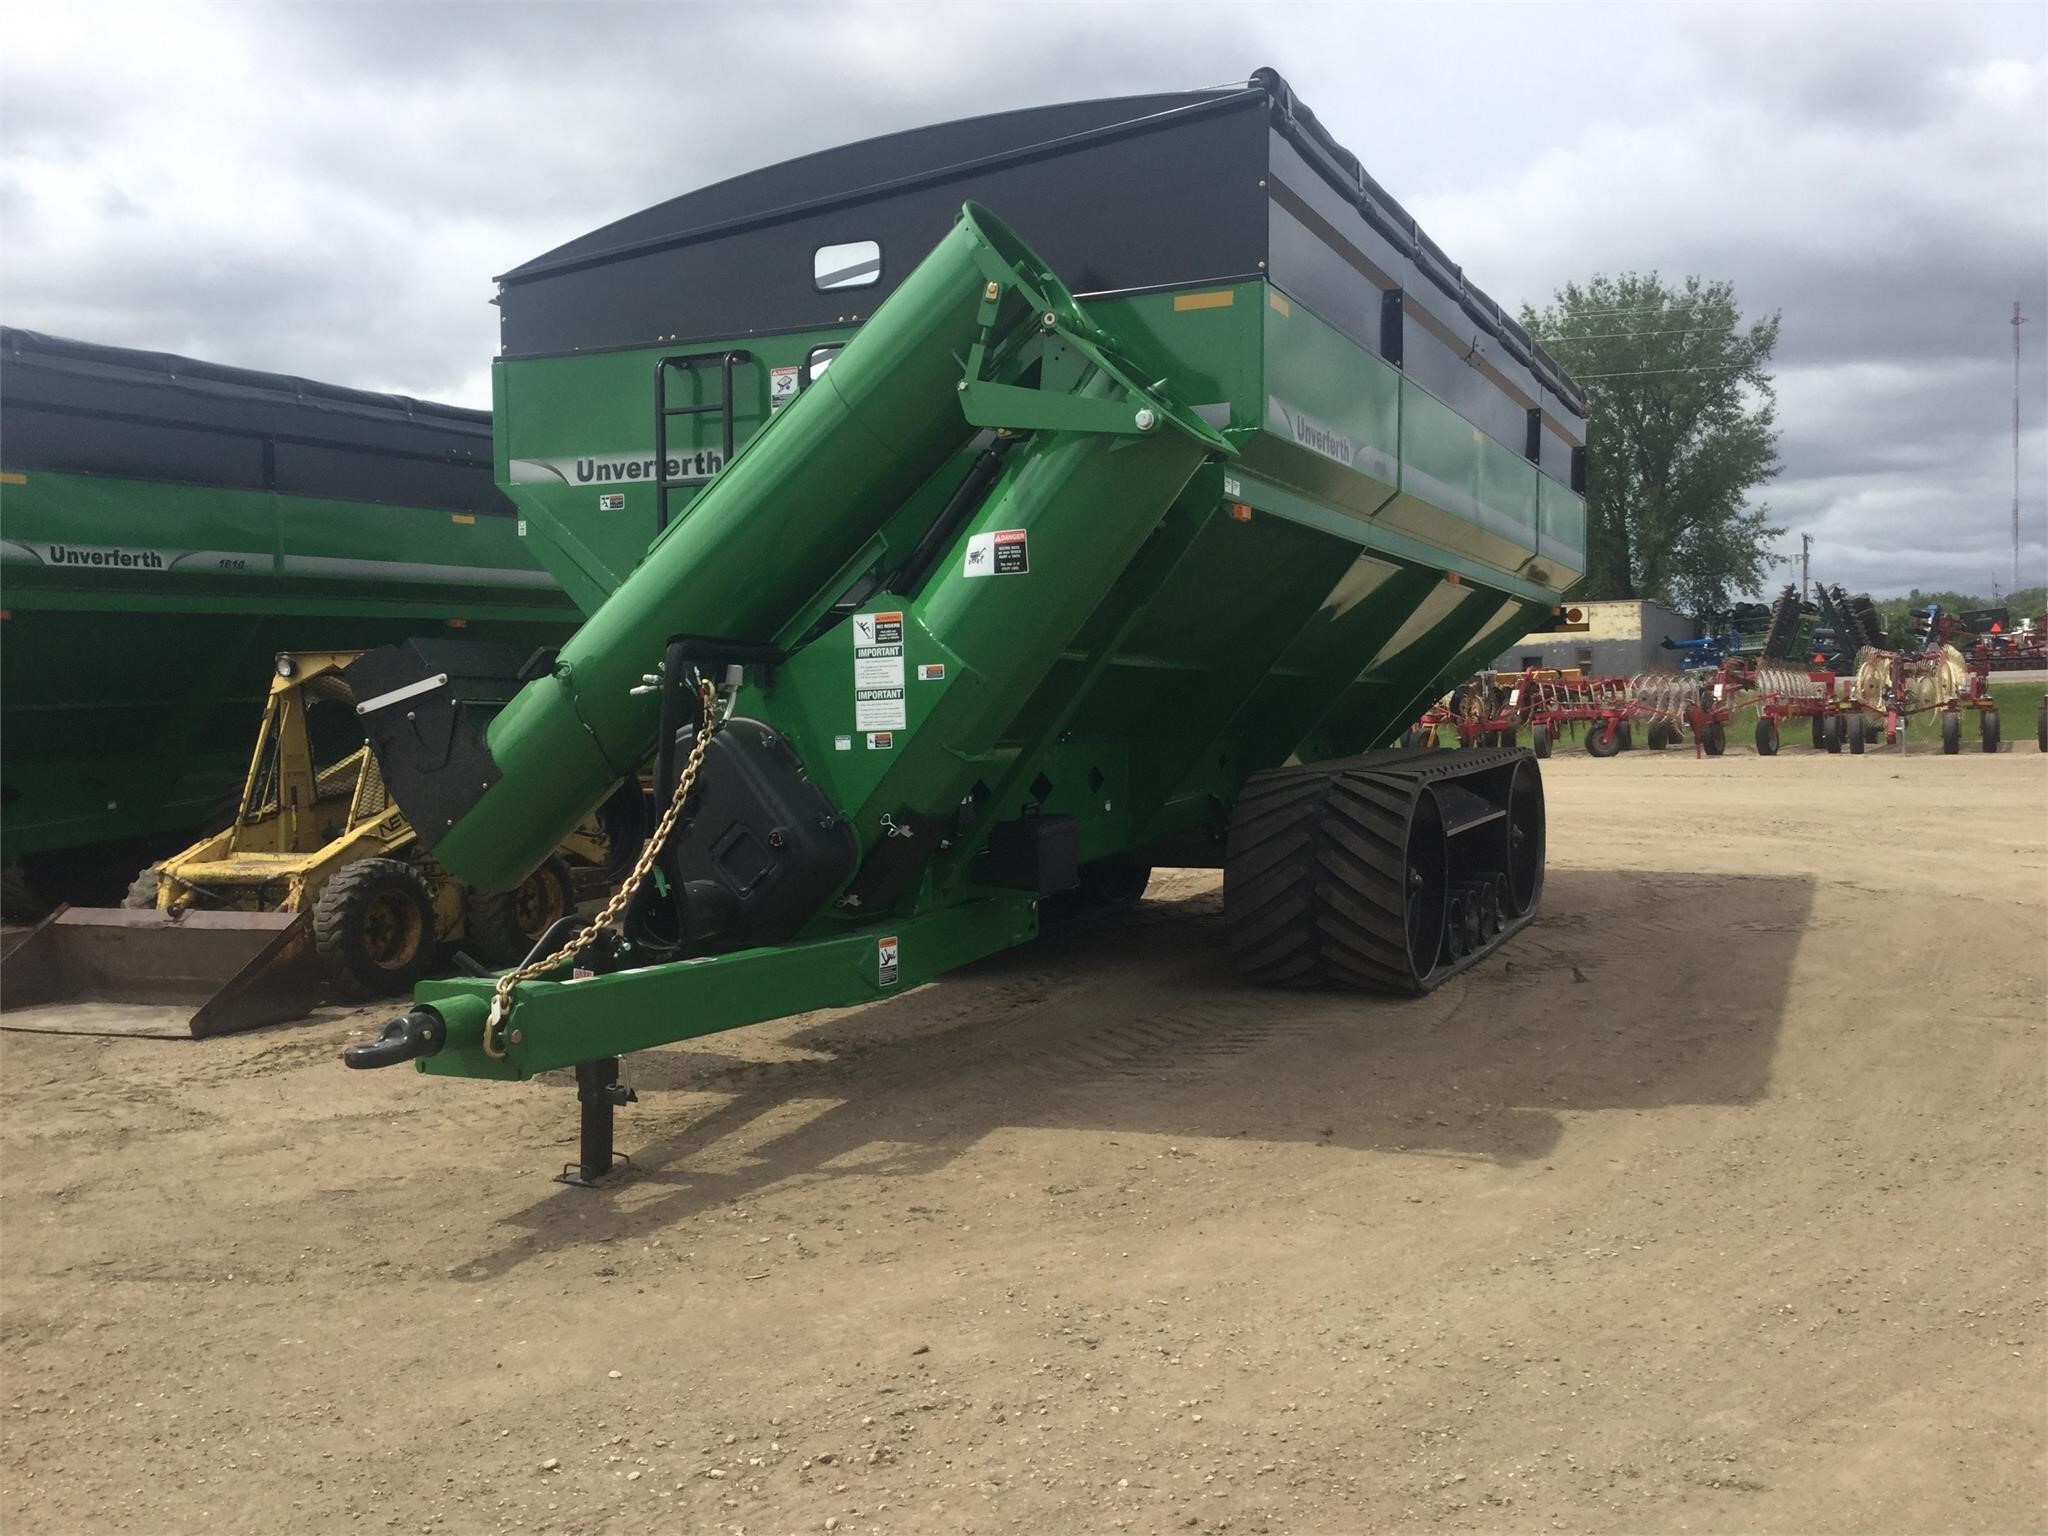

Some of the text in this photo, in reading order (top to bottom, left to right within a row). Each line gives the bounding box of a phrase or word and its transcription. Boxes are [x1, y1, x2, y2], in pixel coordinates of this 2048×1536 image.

[1297, 415, 1350, 463] Unverferth
[50, 546, 163, 568] Unverferth
[858, 646, 900, 658] IMPORTANT
[858, 689, 902, 701] IMPORTANT
